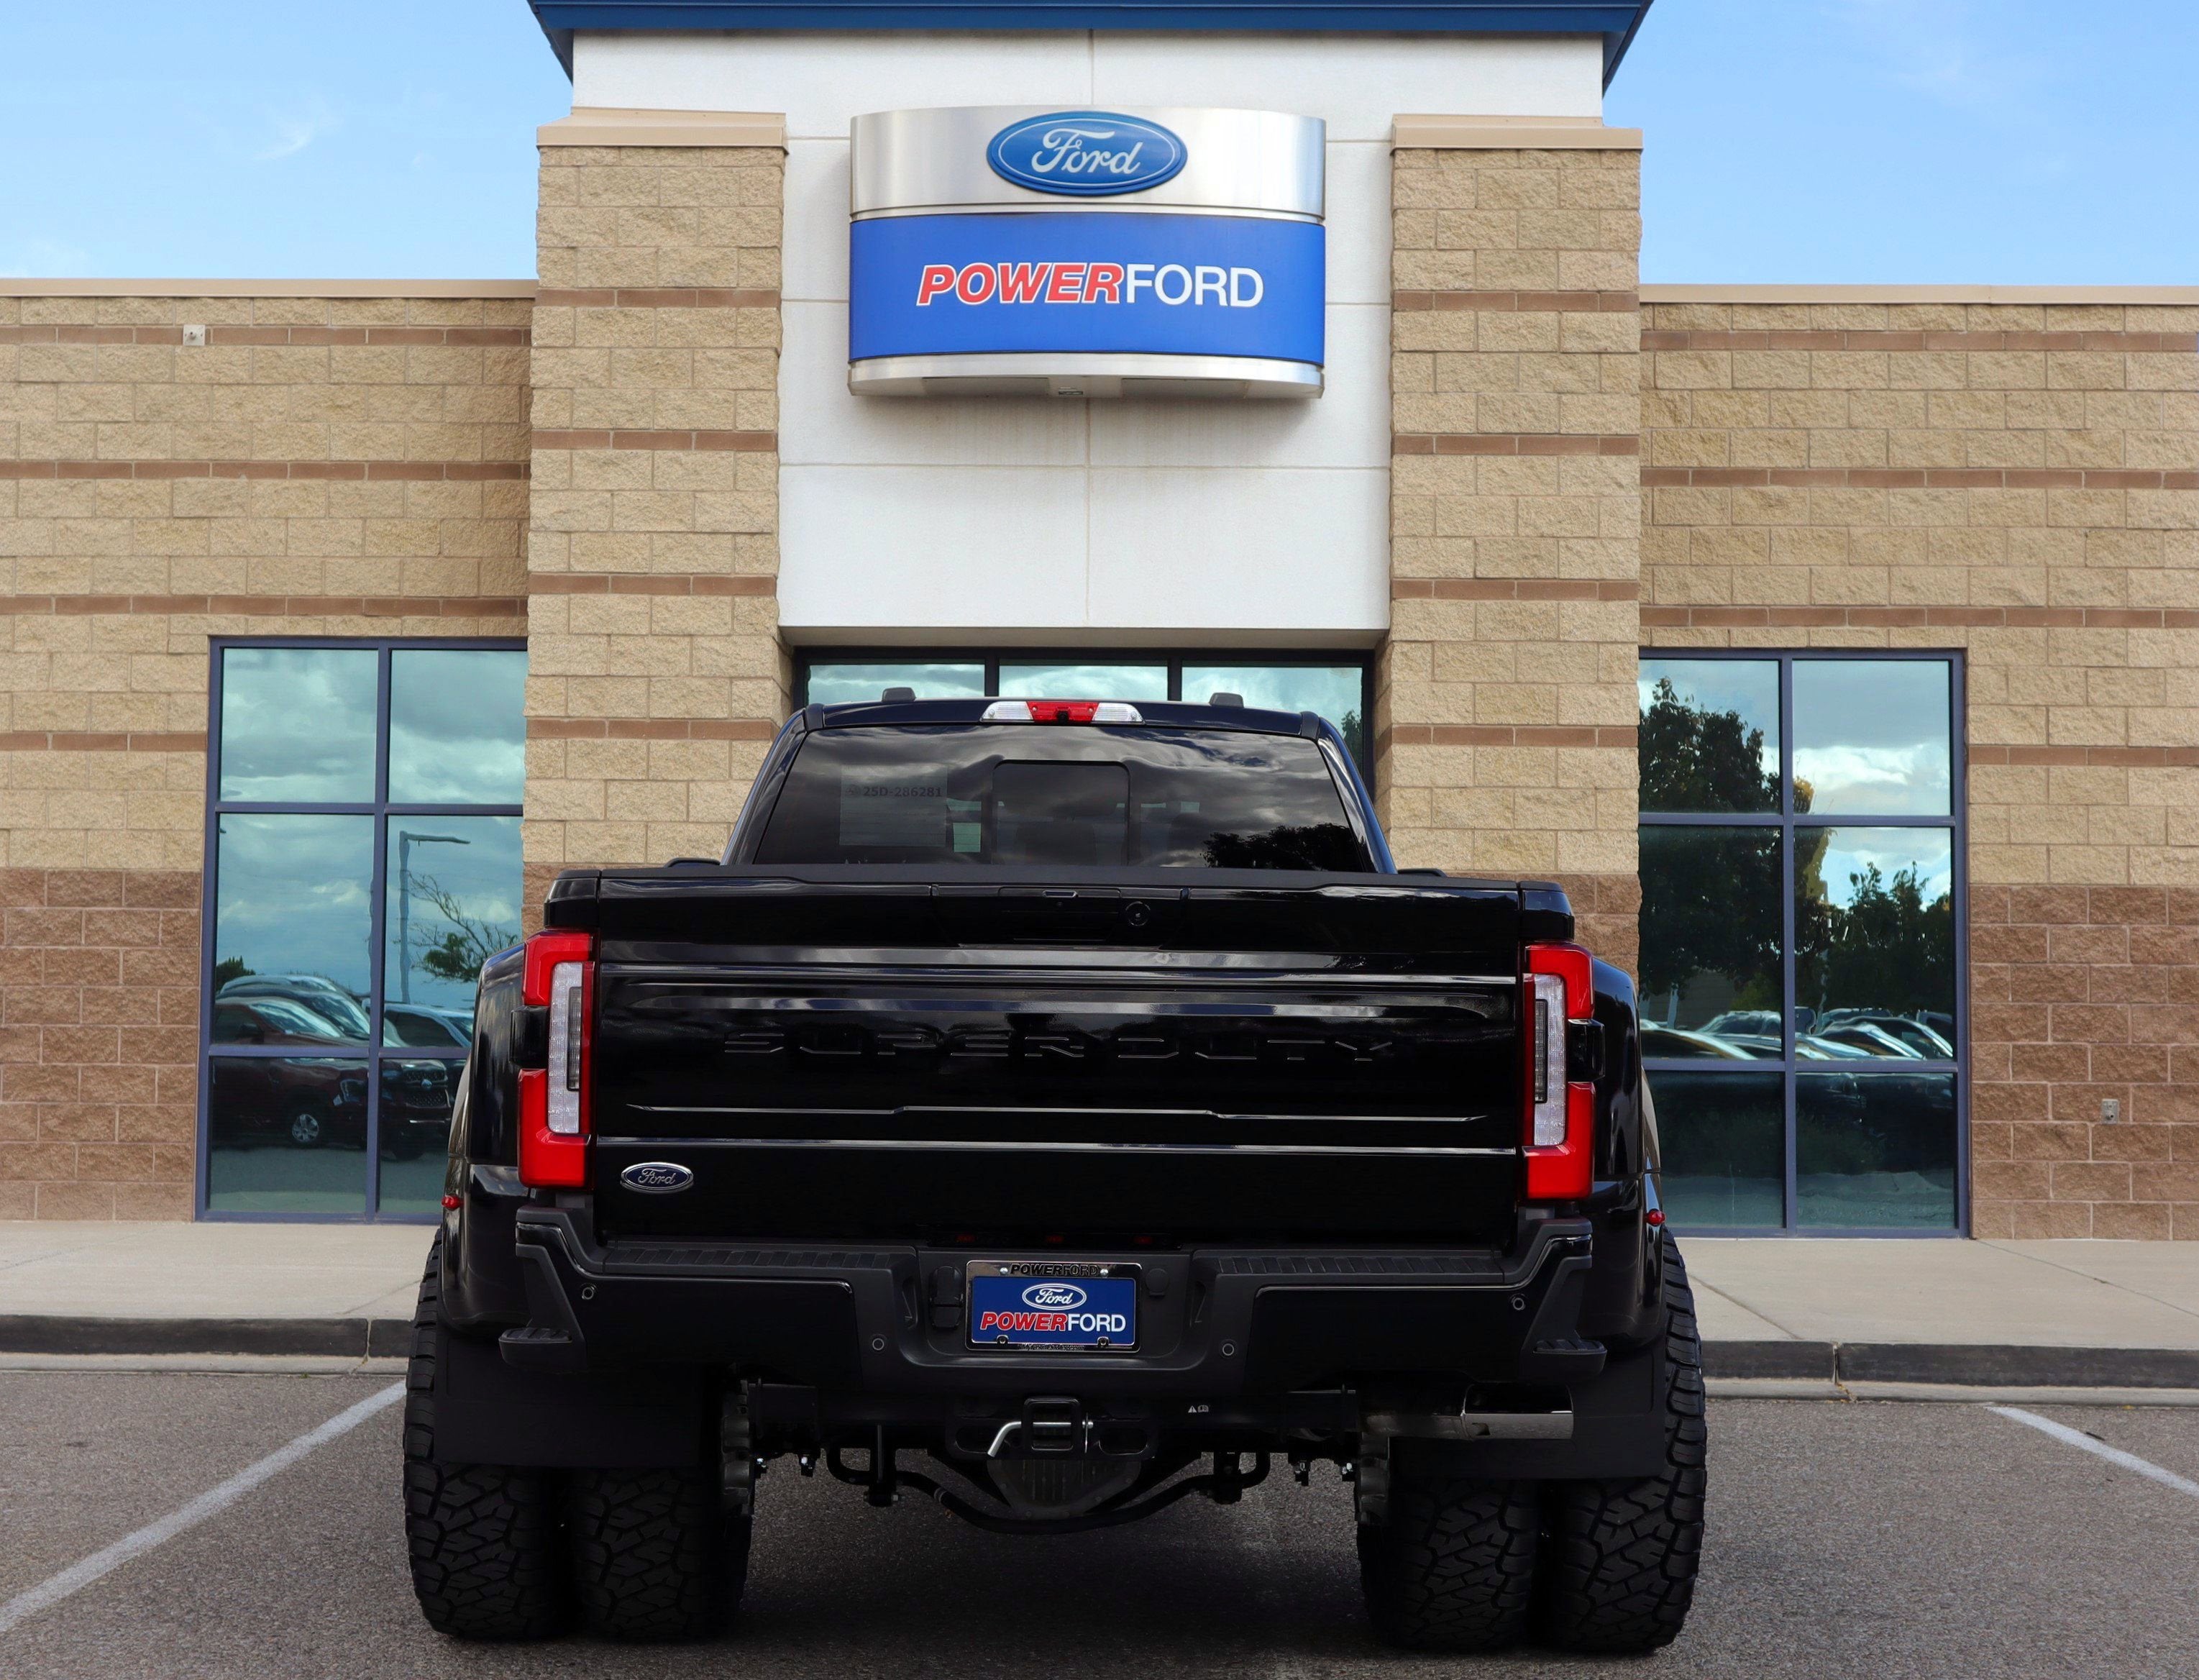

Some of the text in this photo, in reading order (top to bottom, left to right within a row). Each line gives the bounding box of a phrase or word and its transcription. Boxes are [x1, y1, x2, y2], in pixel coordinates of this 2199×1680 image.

[1030, 128, 1143, 174] Ford
[916, 262, 1264, 307] POWERFORD
[638, 1168, 677, 1184] Ford
[1010, 1263, 1100, 1277] POWERFORD
[1035, 1288, 1074, 1305] Ford
[979, 1311, 1127, 1333] POWERFORD
